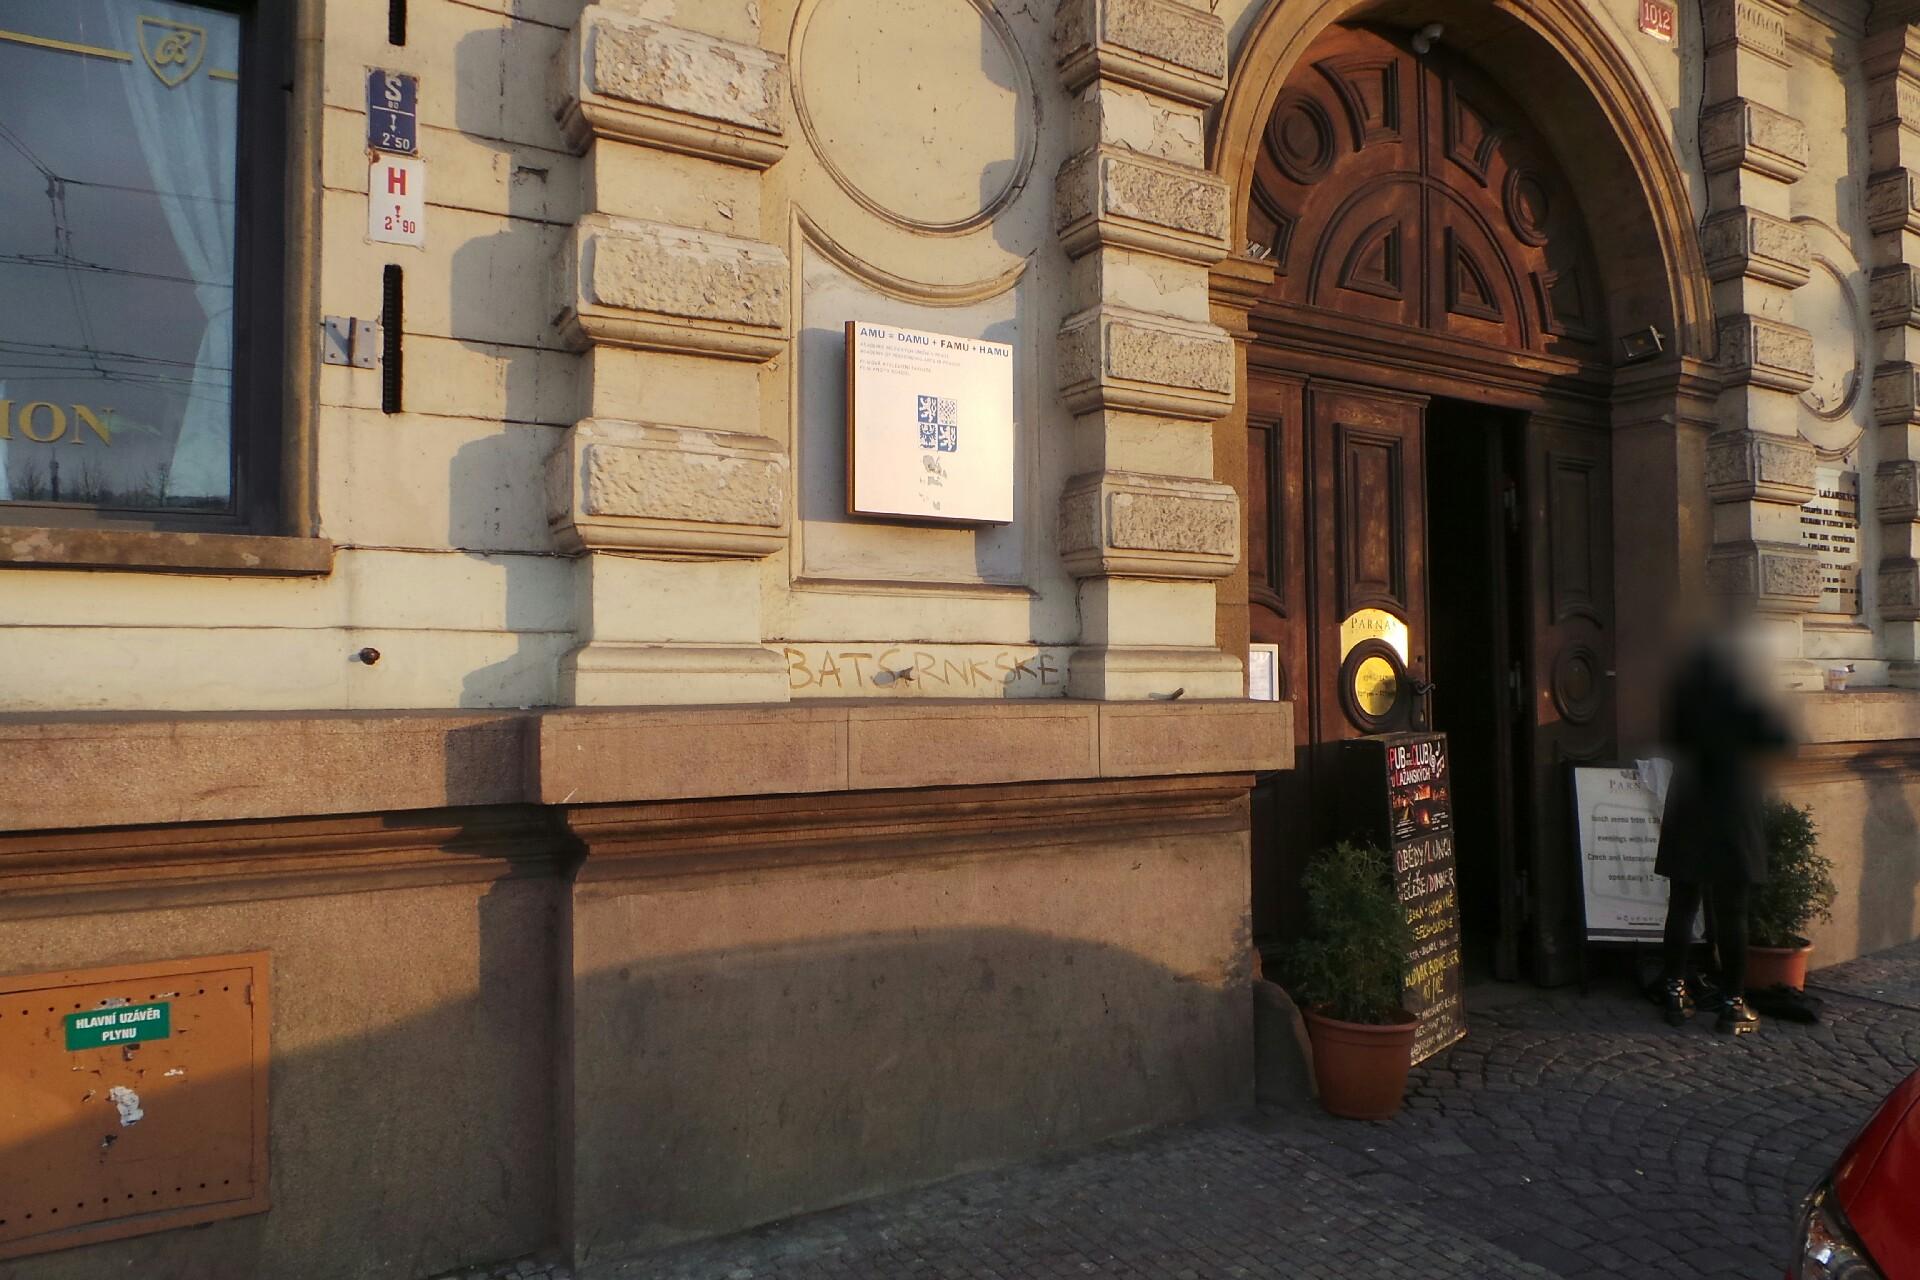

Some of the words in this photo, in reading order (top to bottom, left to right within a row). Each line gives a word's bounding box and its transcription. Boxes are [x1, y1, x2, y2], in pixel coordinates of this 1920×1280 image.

[1645, 2, 1671, 30] 1012
[384, 74, 402, 102] S
[387, 166, 407, 196] H
[860, 327, 885, 339] AMU
[898, 332, 929, 345] DAMU
[940, 339, 969, 352] FAMU
[979, 344, 1009, 357] HAMU
[1389, 747, 1406, 770] PUB
[1411, 743, 1429, 766] CLUB
[1395, 766, 1431, 787] LAŽANSKÝCH
[75, 1012, 117, 1029] HLAVNÍ
[119, 1008, 161, 1024] UZÁVĚR
[102, 1027, 137, 1041] PLYNU
